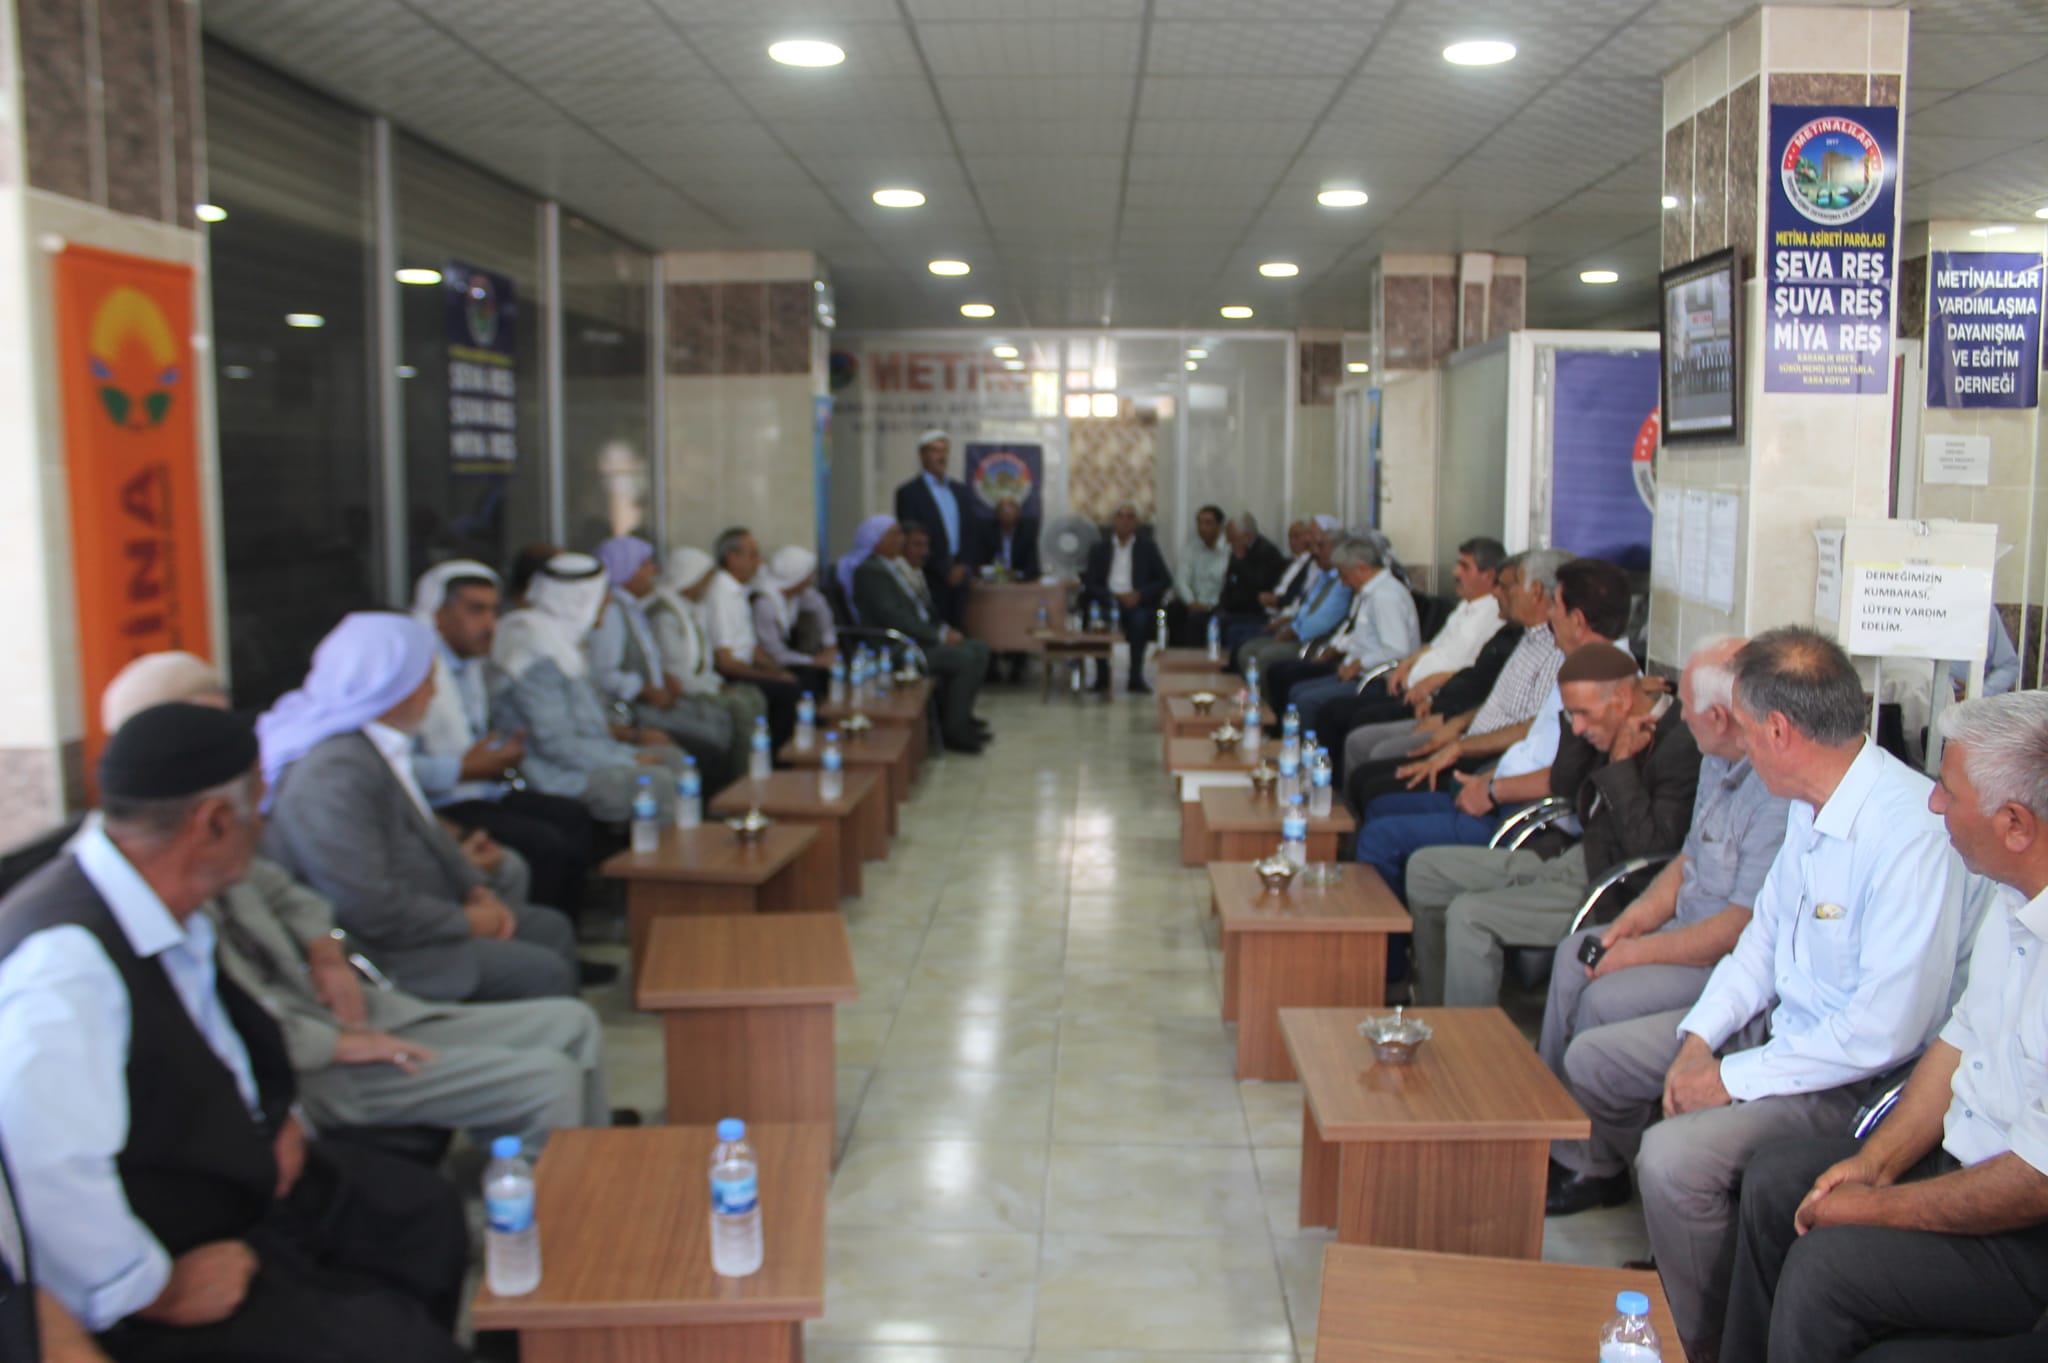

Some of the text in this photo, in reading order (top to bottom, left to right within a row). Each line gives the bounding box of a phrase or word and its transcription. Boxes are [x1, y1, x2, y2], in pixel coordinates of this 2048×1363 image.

[1776, 229, 1885, 248] METİNA AŞİRETİ PAROLASI
[1775, 250, 1885, 285] ŞEVA REŞ
[1937, 266, 2039, 289] METİNALILAR
[1774, 286, 1883, 320] ŞUVA REŞ
[1937, 296, 2038, 320] YARDIMLAŞMA
[1774, 317, 1882, 357] MİYA REŞ
[1947, 323, 2026, 346] DAYANIŞMA
[1951, 345, 2020, 368] VE EĞİTİM
[1954, 372, 2015, 394] DERNEĞİ
[1865, 569, 1943, 584] DERNEĞİMİZİN
[1862, 603, 1901, 617] LÜTFEN
